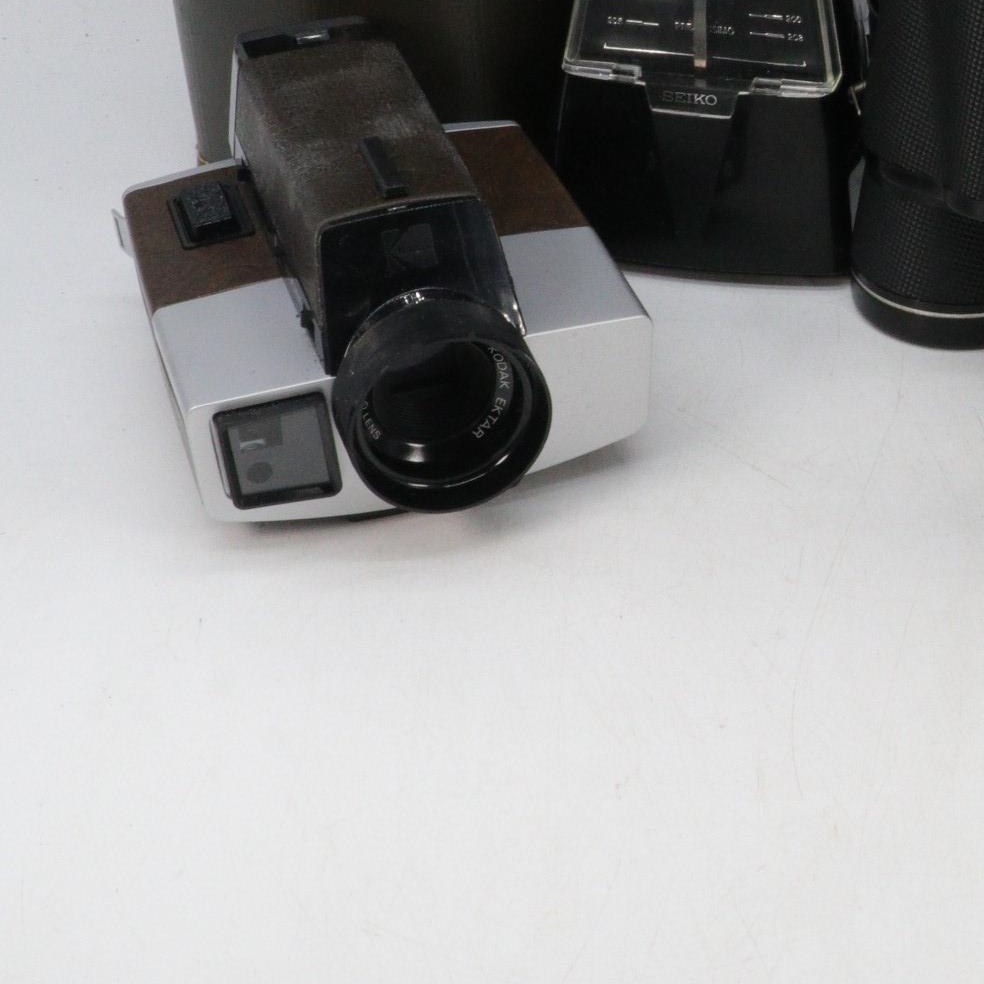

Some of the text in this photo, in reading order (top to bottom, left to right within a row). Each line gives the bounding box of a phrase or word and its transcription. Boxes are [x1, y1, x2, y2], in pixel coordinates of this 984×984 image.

[662, 90, 718, 106] SEIKO
[472, 345, 511, 440] KODAK EKTAR
[361, 412, 382, 440] LENS
